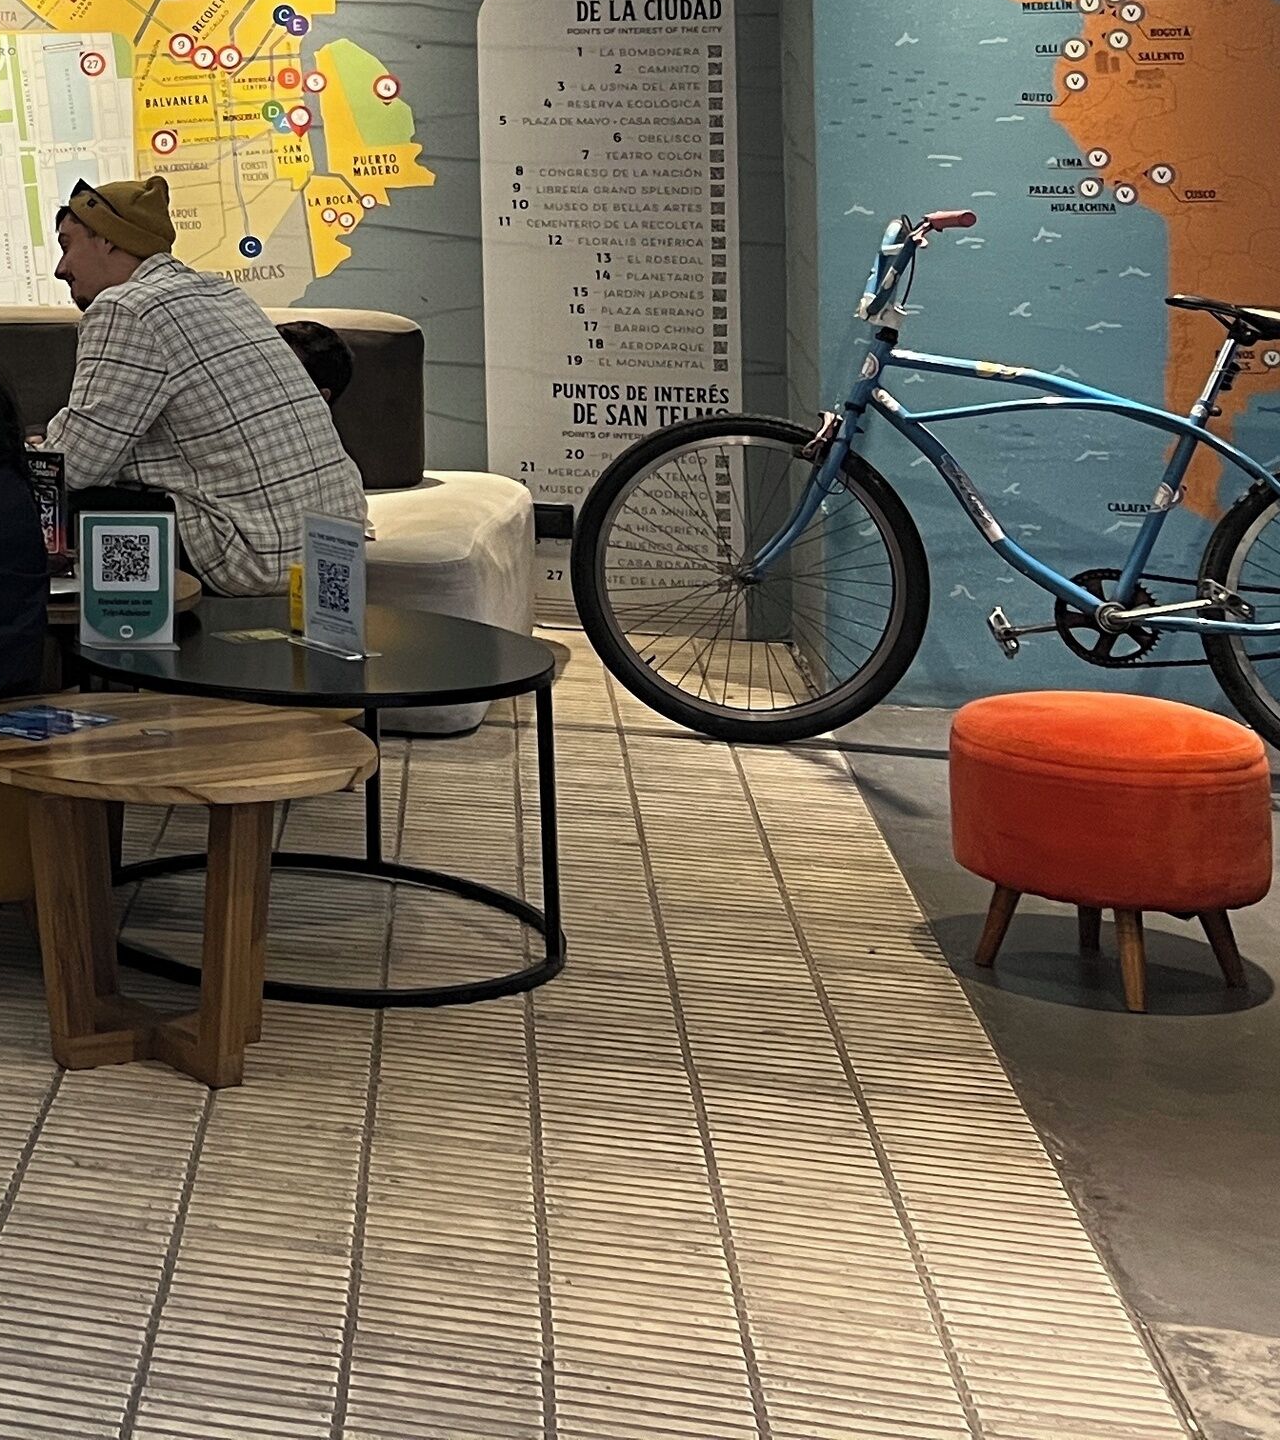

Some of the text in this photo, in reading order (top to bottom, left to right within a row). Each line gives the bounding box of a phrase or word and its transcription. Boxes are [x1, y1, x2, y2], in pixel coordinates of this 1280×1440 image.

[576, 0, 601, 22] DE
[609, 0, 636, 22] LA
[567, 26, 722, 36] POINTS OF INTEREST OF THE CITY
[599, 48, 616, 57] LA
[618, 47, 700, 57] BOMBONERA
[1035, 44, 1058, 54] CALI
[1138, 51, 1185, 61] SALENTO
[614, 64, 700, 74] 2 CAMINITO
[557, 81, 701, 92] 3 LA USINA DEL ARTE
[145, 94, 209, 109] BALVANERA
[1020, 92, 1054, 103] QUITO
[613, 132, 702, 144] 6 OBELISCO
[283, 144, 302, 154] SAN
[278, 155, 310, 165] TELMO
[353, 153, 397, 166] PUERTO
[353, 164, 400, 176] MADERO
[1028, 185, 1075, 195] PARACAS
[1184, 189, 1216, 199] CUSCO
[308, 195, 353, 207] LA BOCA
[1050, 203, 1116, 212] HUACACHINA
[595, 269, 705, 283] 14 PLANETARIO
[552, 383, 730, 404] PUNTOS DE INTERÉS
[573, 403, 648, 427] DE SAN
